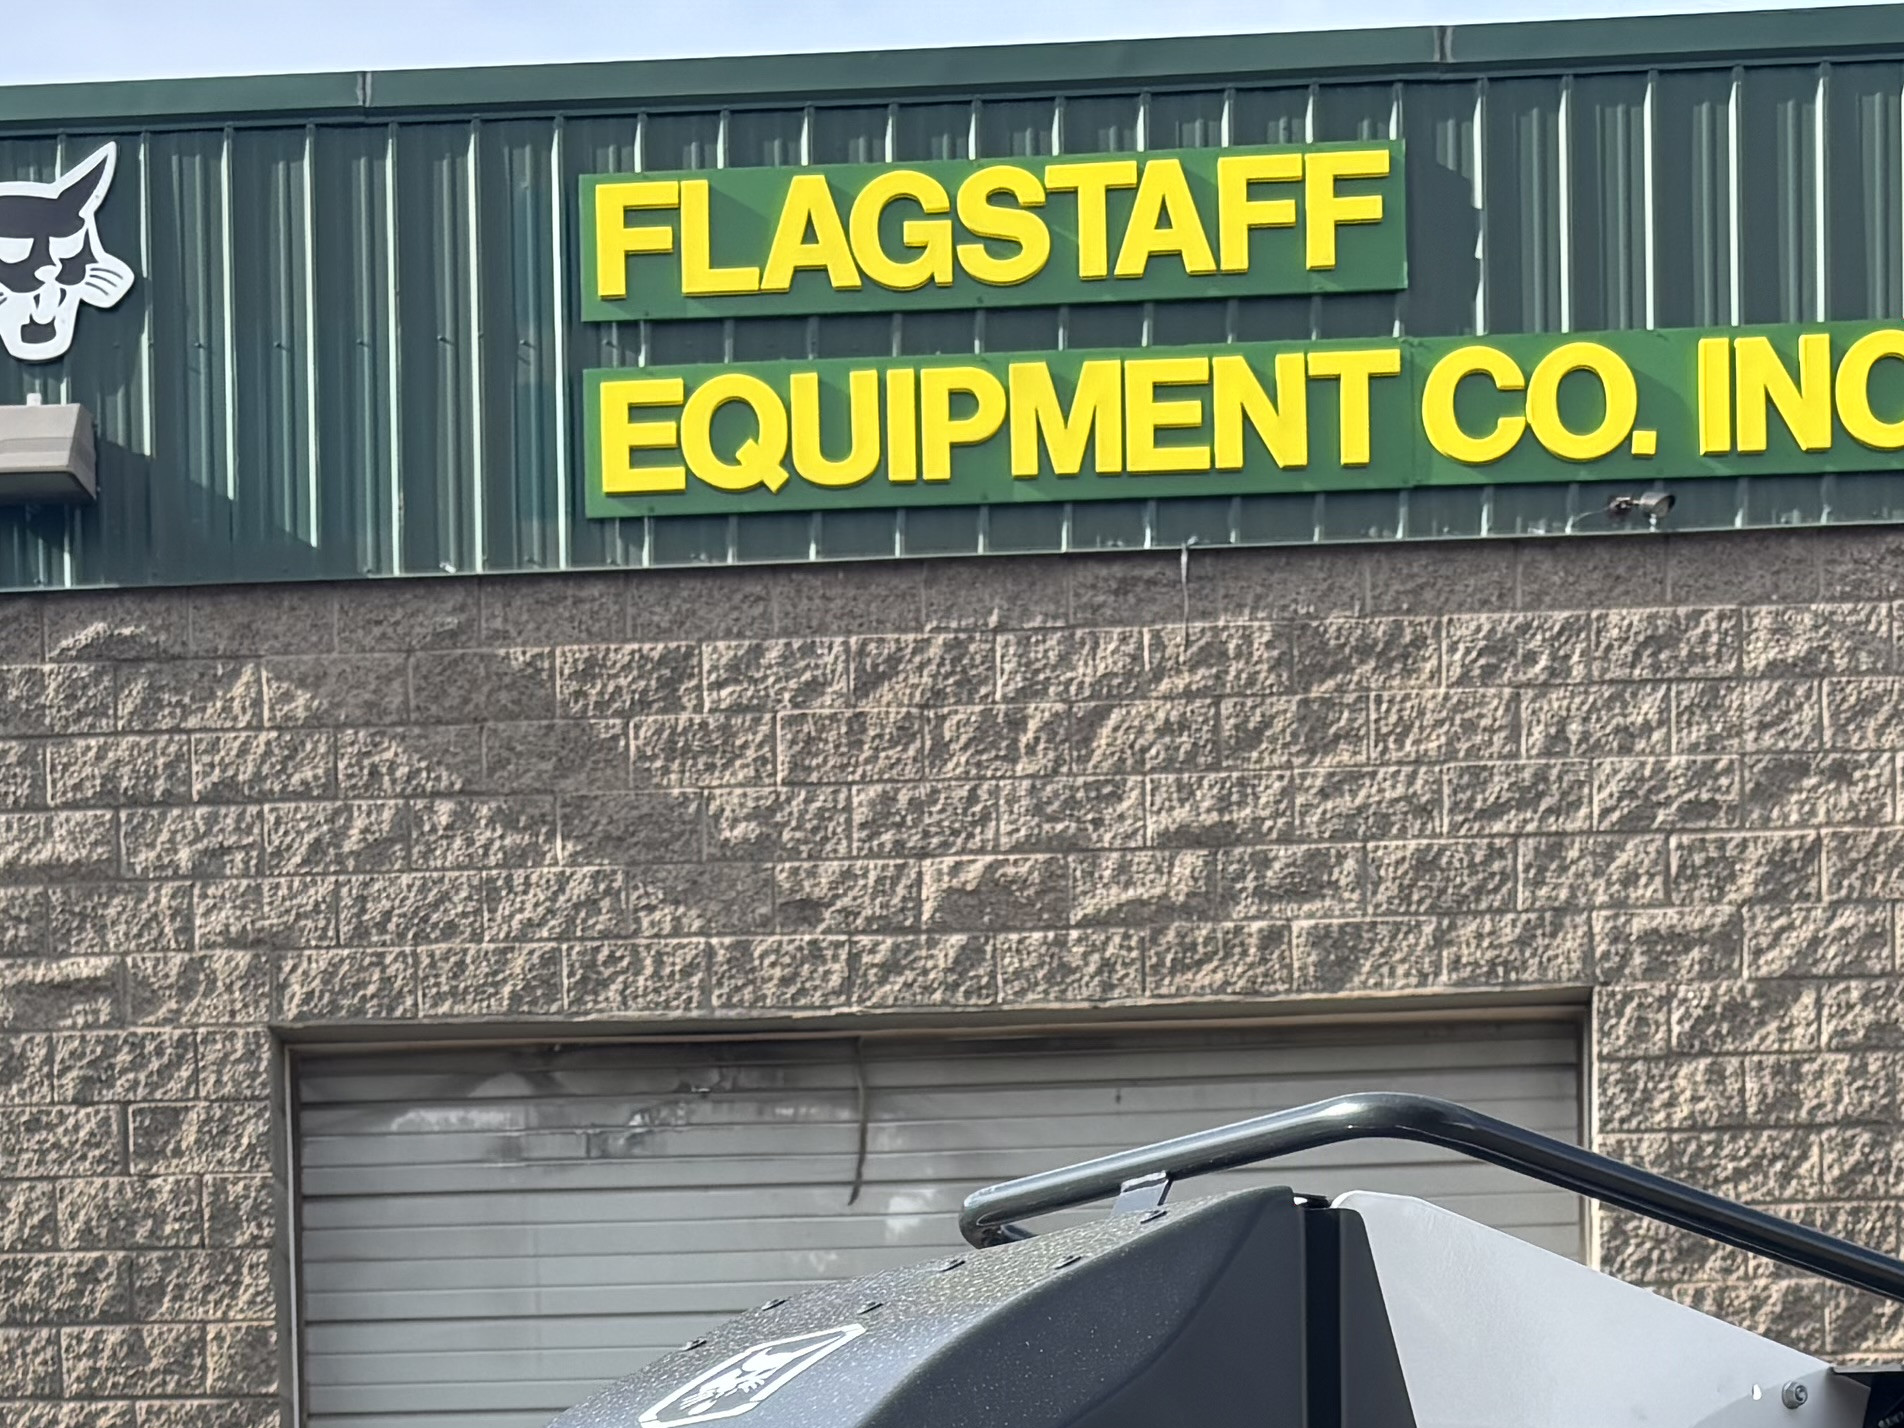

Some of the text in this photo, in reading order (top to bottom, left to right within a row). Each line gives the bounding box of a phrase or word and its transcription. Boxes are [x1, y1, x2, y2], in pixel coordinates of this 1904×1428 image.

[594, 148, 1391, 300] FLAGSTAFF
[599, 348, 1402, 495] EQUIPMENT
[1421, 341, 1657, 463] CO.
